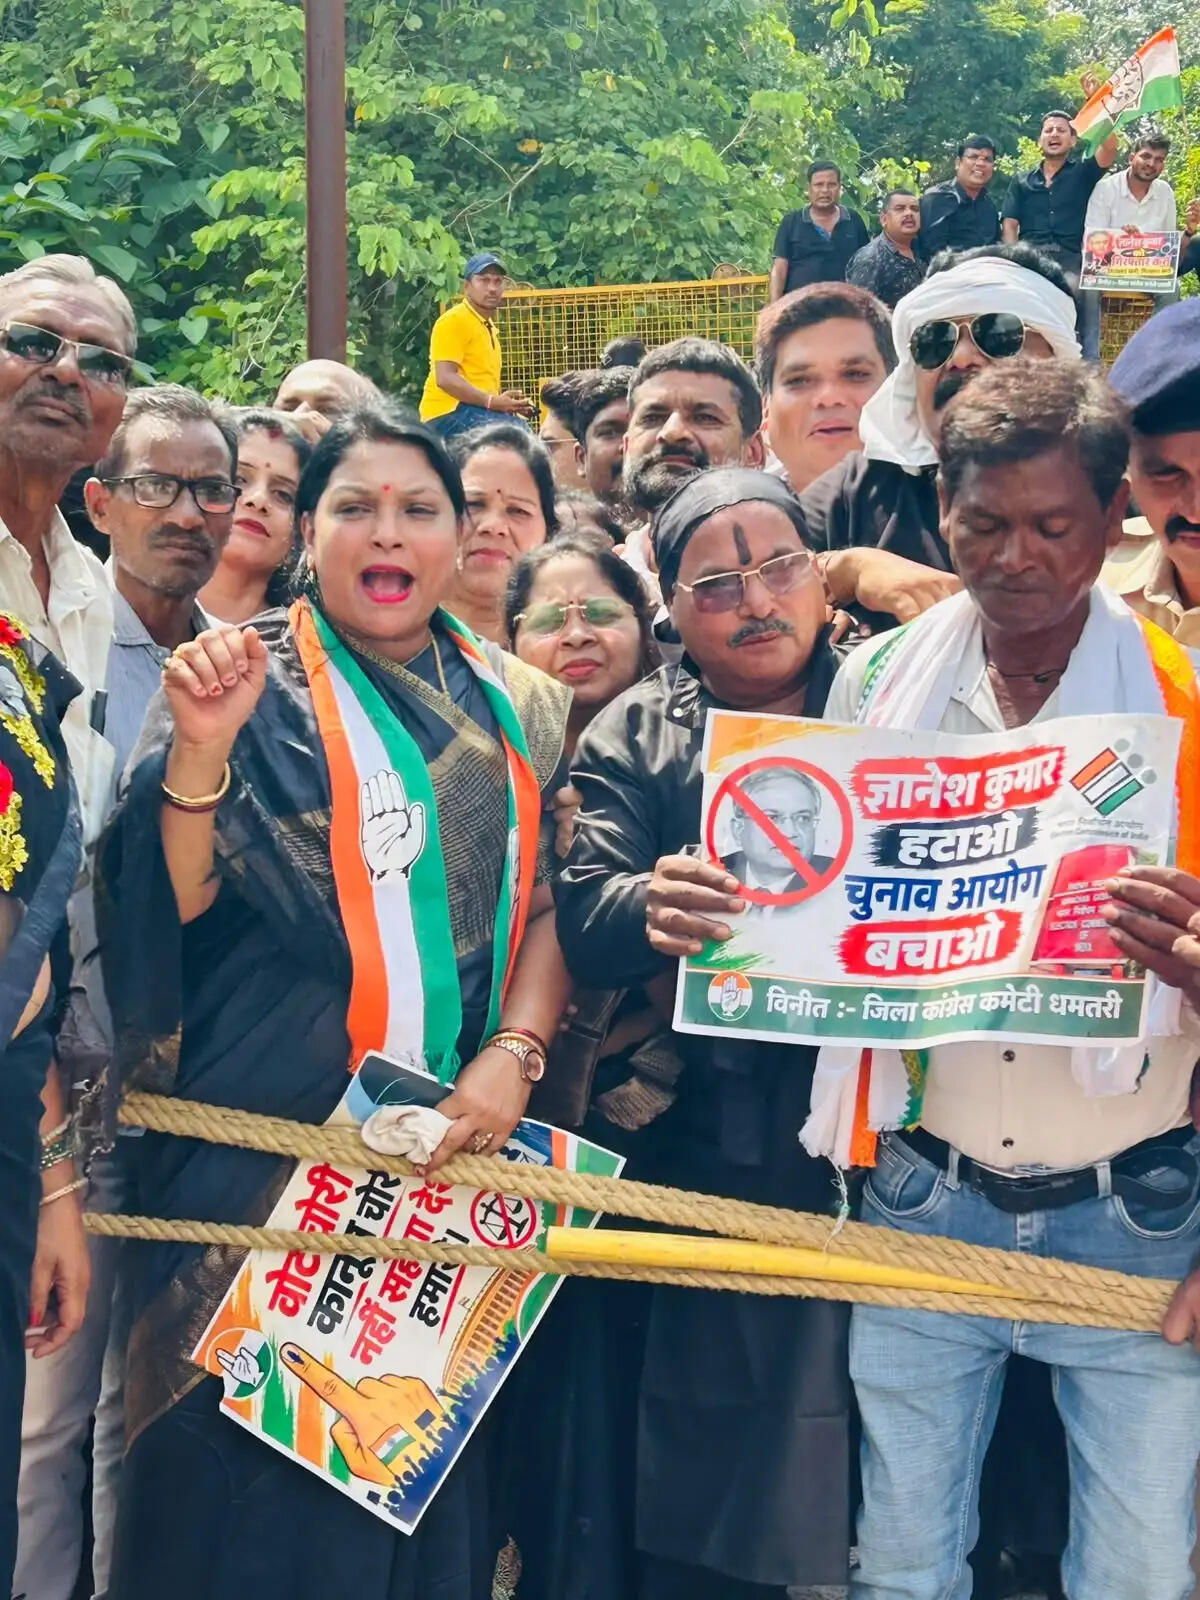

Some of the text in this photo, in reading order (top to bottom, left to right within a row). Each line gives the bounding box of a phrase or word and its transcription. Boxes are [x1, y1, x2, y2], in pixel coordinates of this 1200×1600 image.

[863, 750, 1060, 814] ज्ञानेश कुमार
[898, 810, 1023, 866] हटाओ
[844, 858, 1047, 921] चुनाव आयोग
[864, 914, 1006, 971] बचाओ
[766, 986, 831, 1019] विनीत
[862, 989, 918, 1022] जिला
[922, 991, 973, 1021] कांग्रेस
[979, 983, 1043, 1015] कमेटी
[1049, 989, 1123, 1020] धमतरी
[295, 1161, 354, 1234] चोरी
[355, 1168, 401, 1221] चोर
[350, 1297, 397, 1365] नहीं
